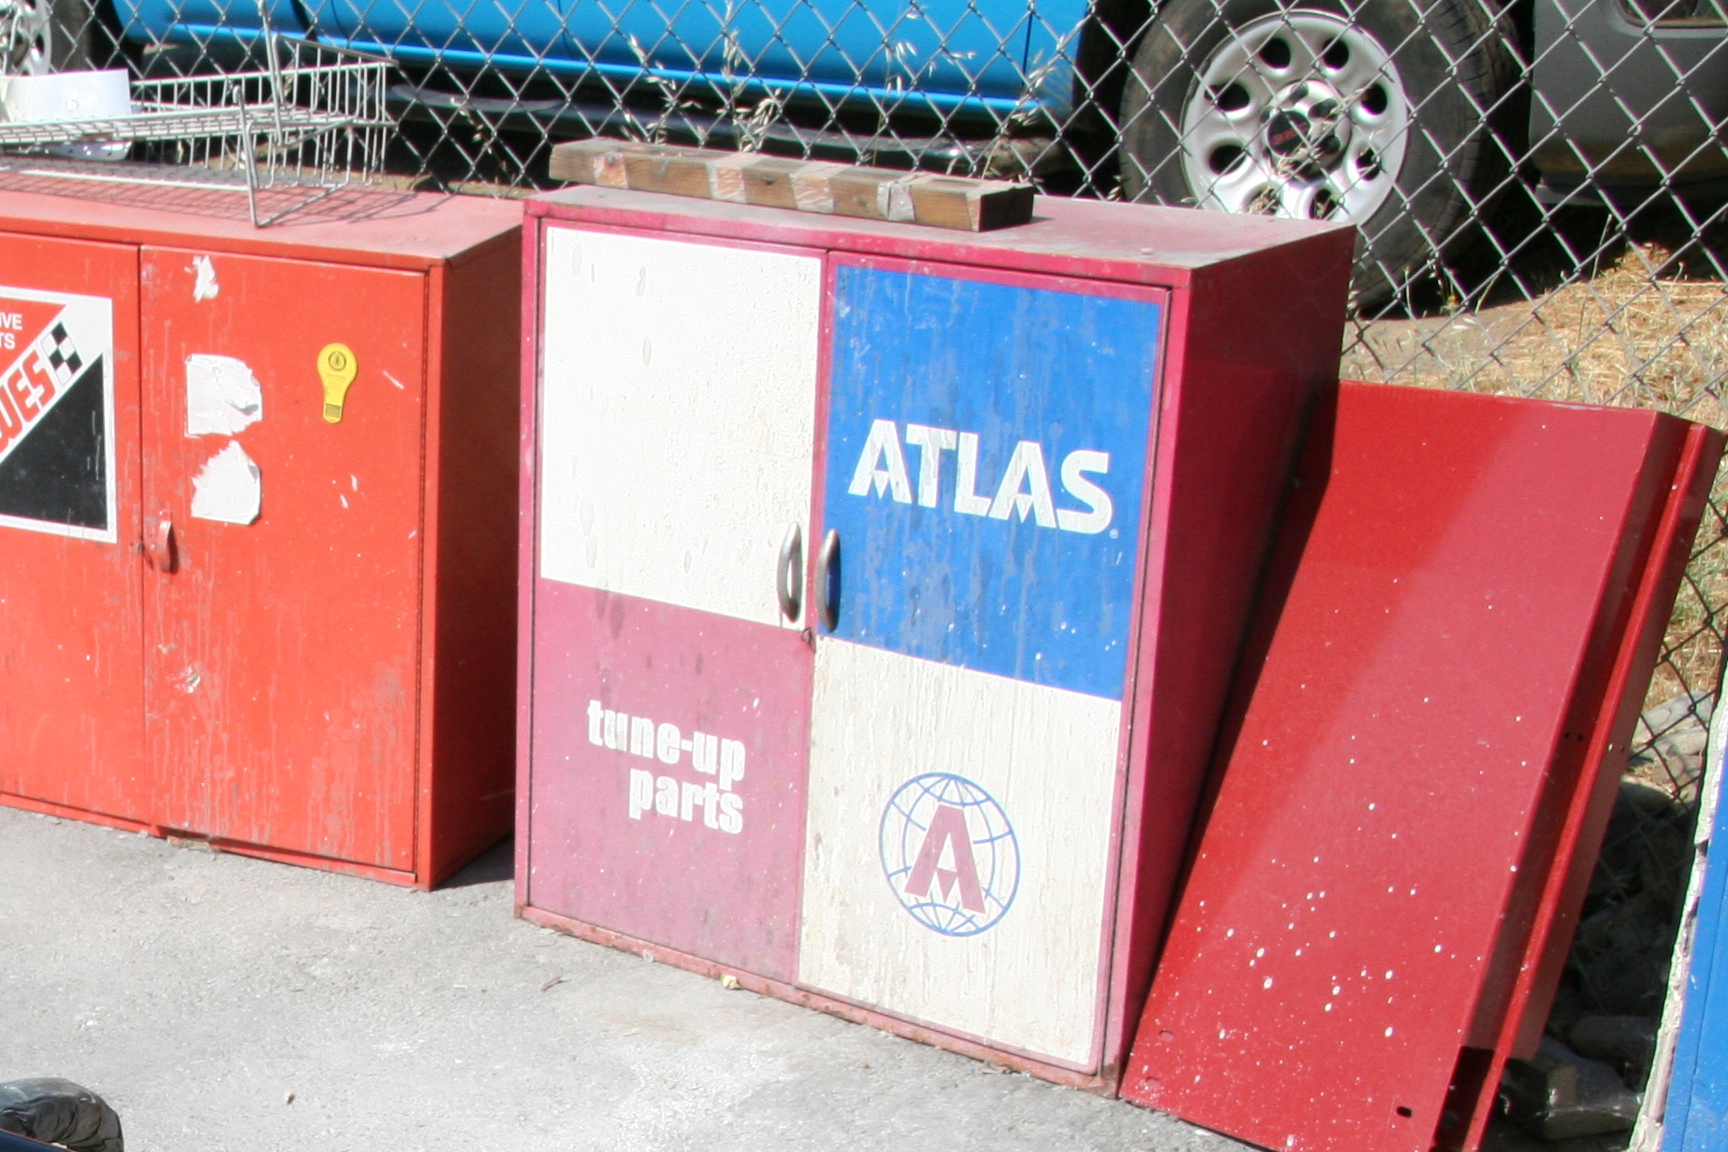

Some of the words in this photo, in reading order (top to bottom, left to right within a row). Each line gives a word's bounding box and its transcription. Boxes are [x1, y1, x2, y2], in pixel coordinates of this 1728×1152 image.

[847, 418, 1113, 536] ATLAS
[587, 699, 746, 791] tune-up
[629, 768, 744, 834] parts
